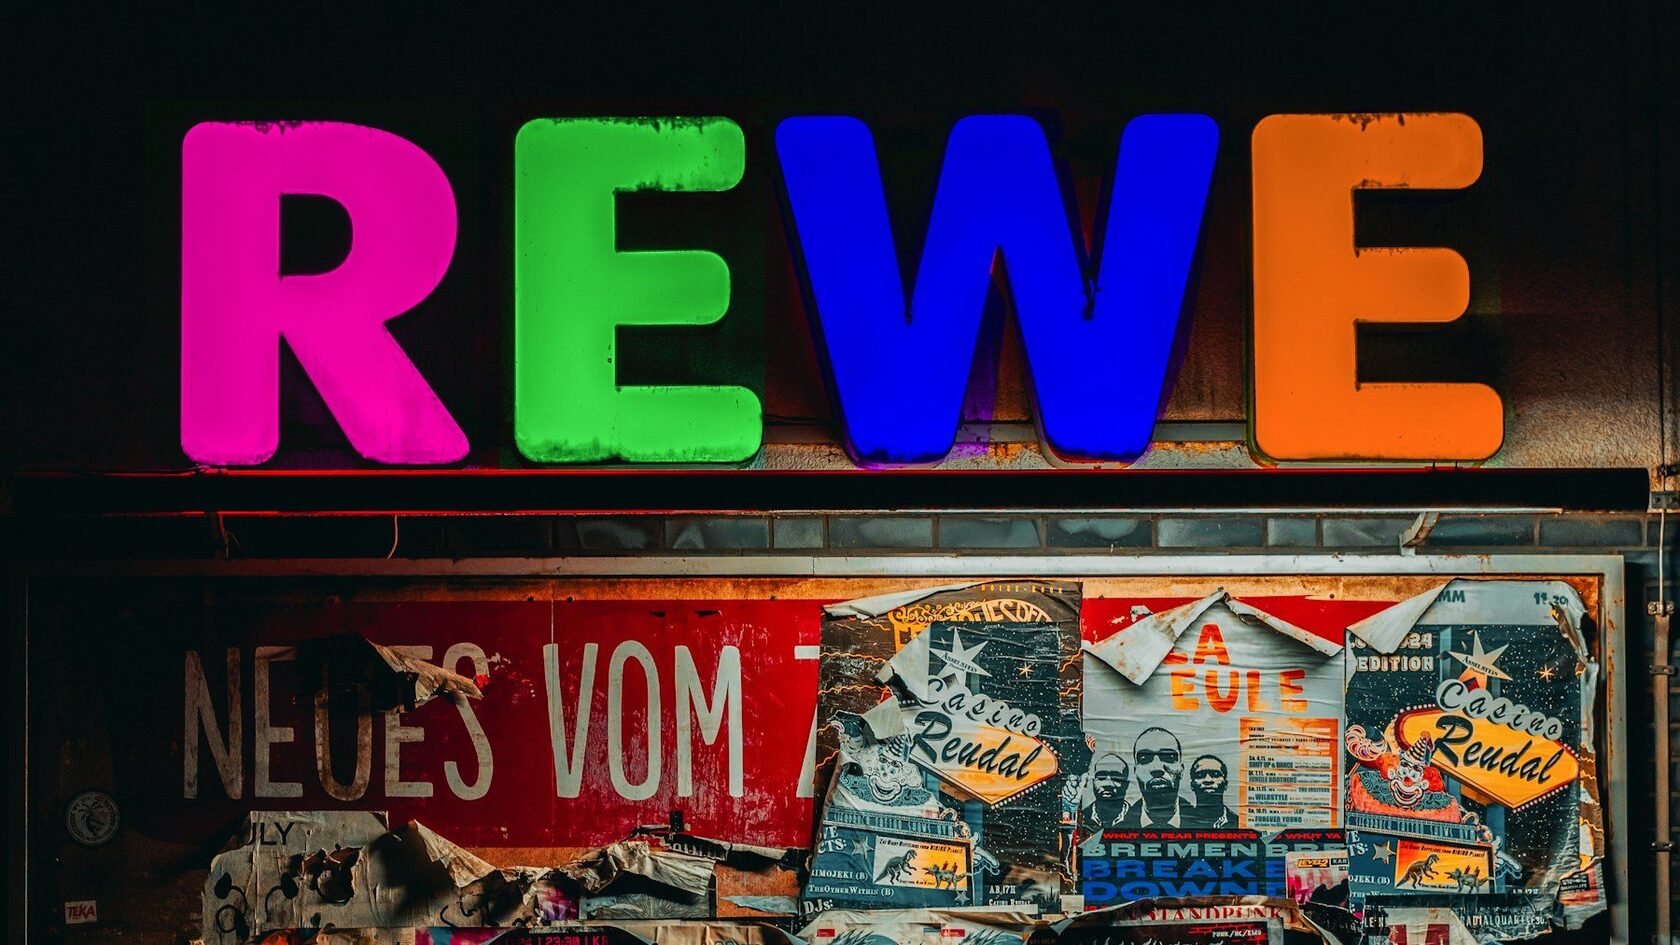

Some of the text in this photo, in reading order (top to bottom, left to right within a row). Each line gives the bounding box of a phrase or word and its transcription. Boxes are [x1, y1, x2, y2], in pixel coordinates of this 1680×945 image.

[181, 112, 1504, 465] REWE
[1357, 656, 1434, 672] EDITION
[1170, 667, 1309, 714] EULE
[1440, 681, 1560, 735] Casino
[184, 642, 494, 801] NEUES
[543, 640, 744, 801] VOM
[1161, 833, 1192, 841] FEAR
[1195, 832, 1257, 841] PRESENTS
[1083, 843, 1257, 857] BREMEN
[855, 872, 869, 881] (B)
[1083, 859, 1263, 878] BREAK
[1377, 876, 1390, 885] (B)
[881, 888, 894, 897] (B)
